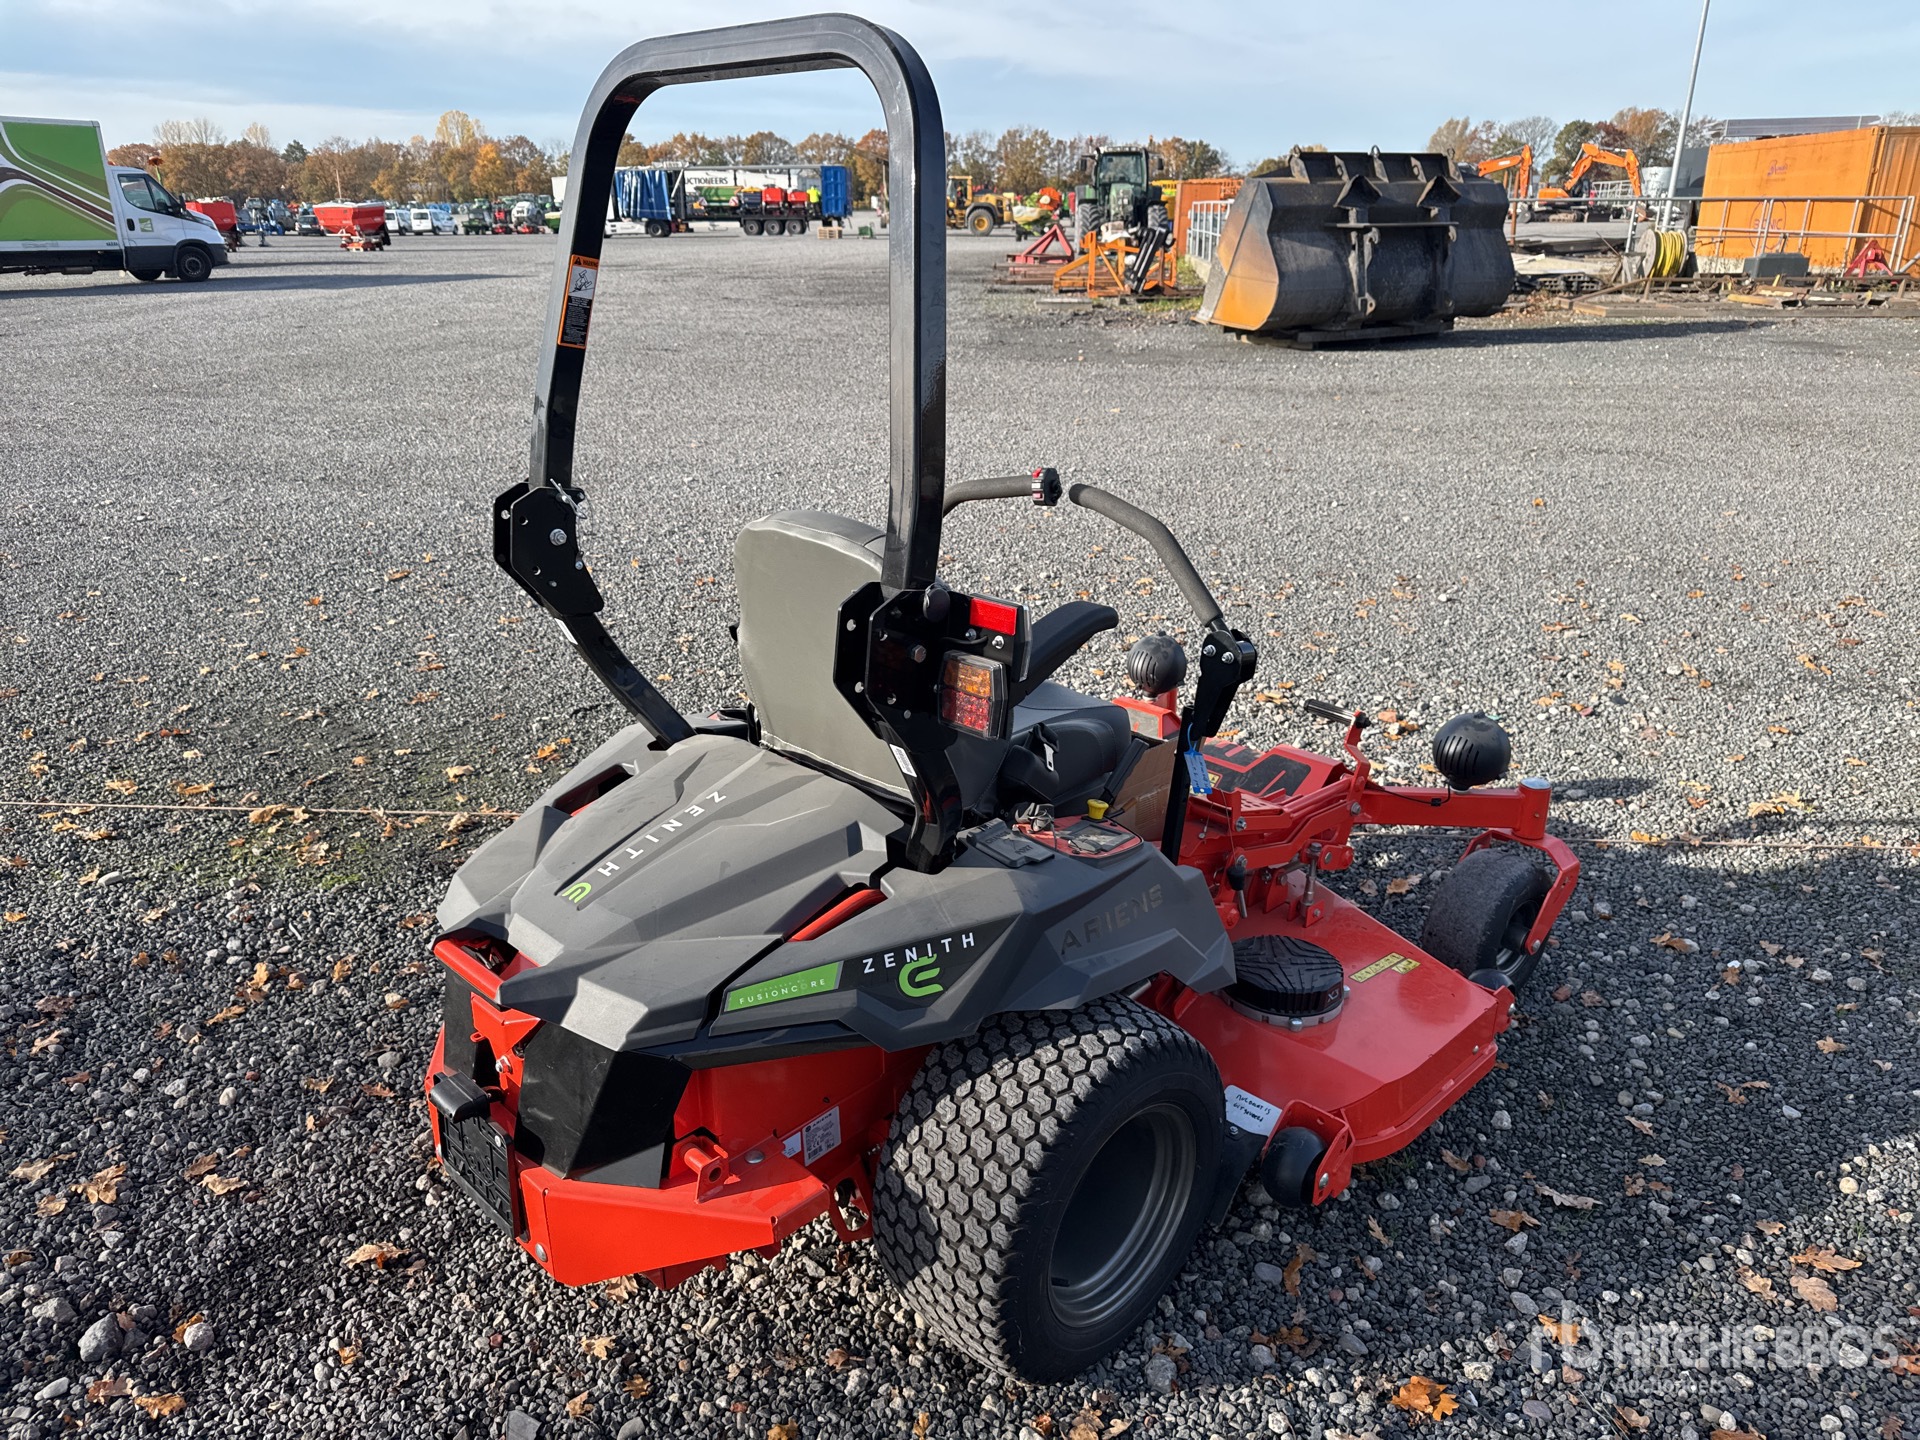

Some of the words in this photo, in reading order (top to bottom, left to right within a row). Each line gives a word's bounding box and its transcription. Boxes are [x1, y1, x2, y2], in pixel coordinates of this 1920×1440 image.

[685, 177, 729, 185] UCTIONEERS
[597, 791, 727, 876] ZENITH
[1060, 883, 1164, 955] ARIENS
[863, 932, 975, 974] ZENITH
[739, 977, 826, 1005] FUSIONCORE
